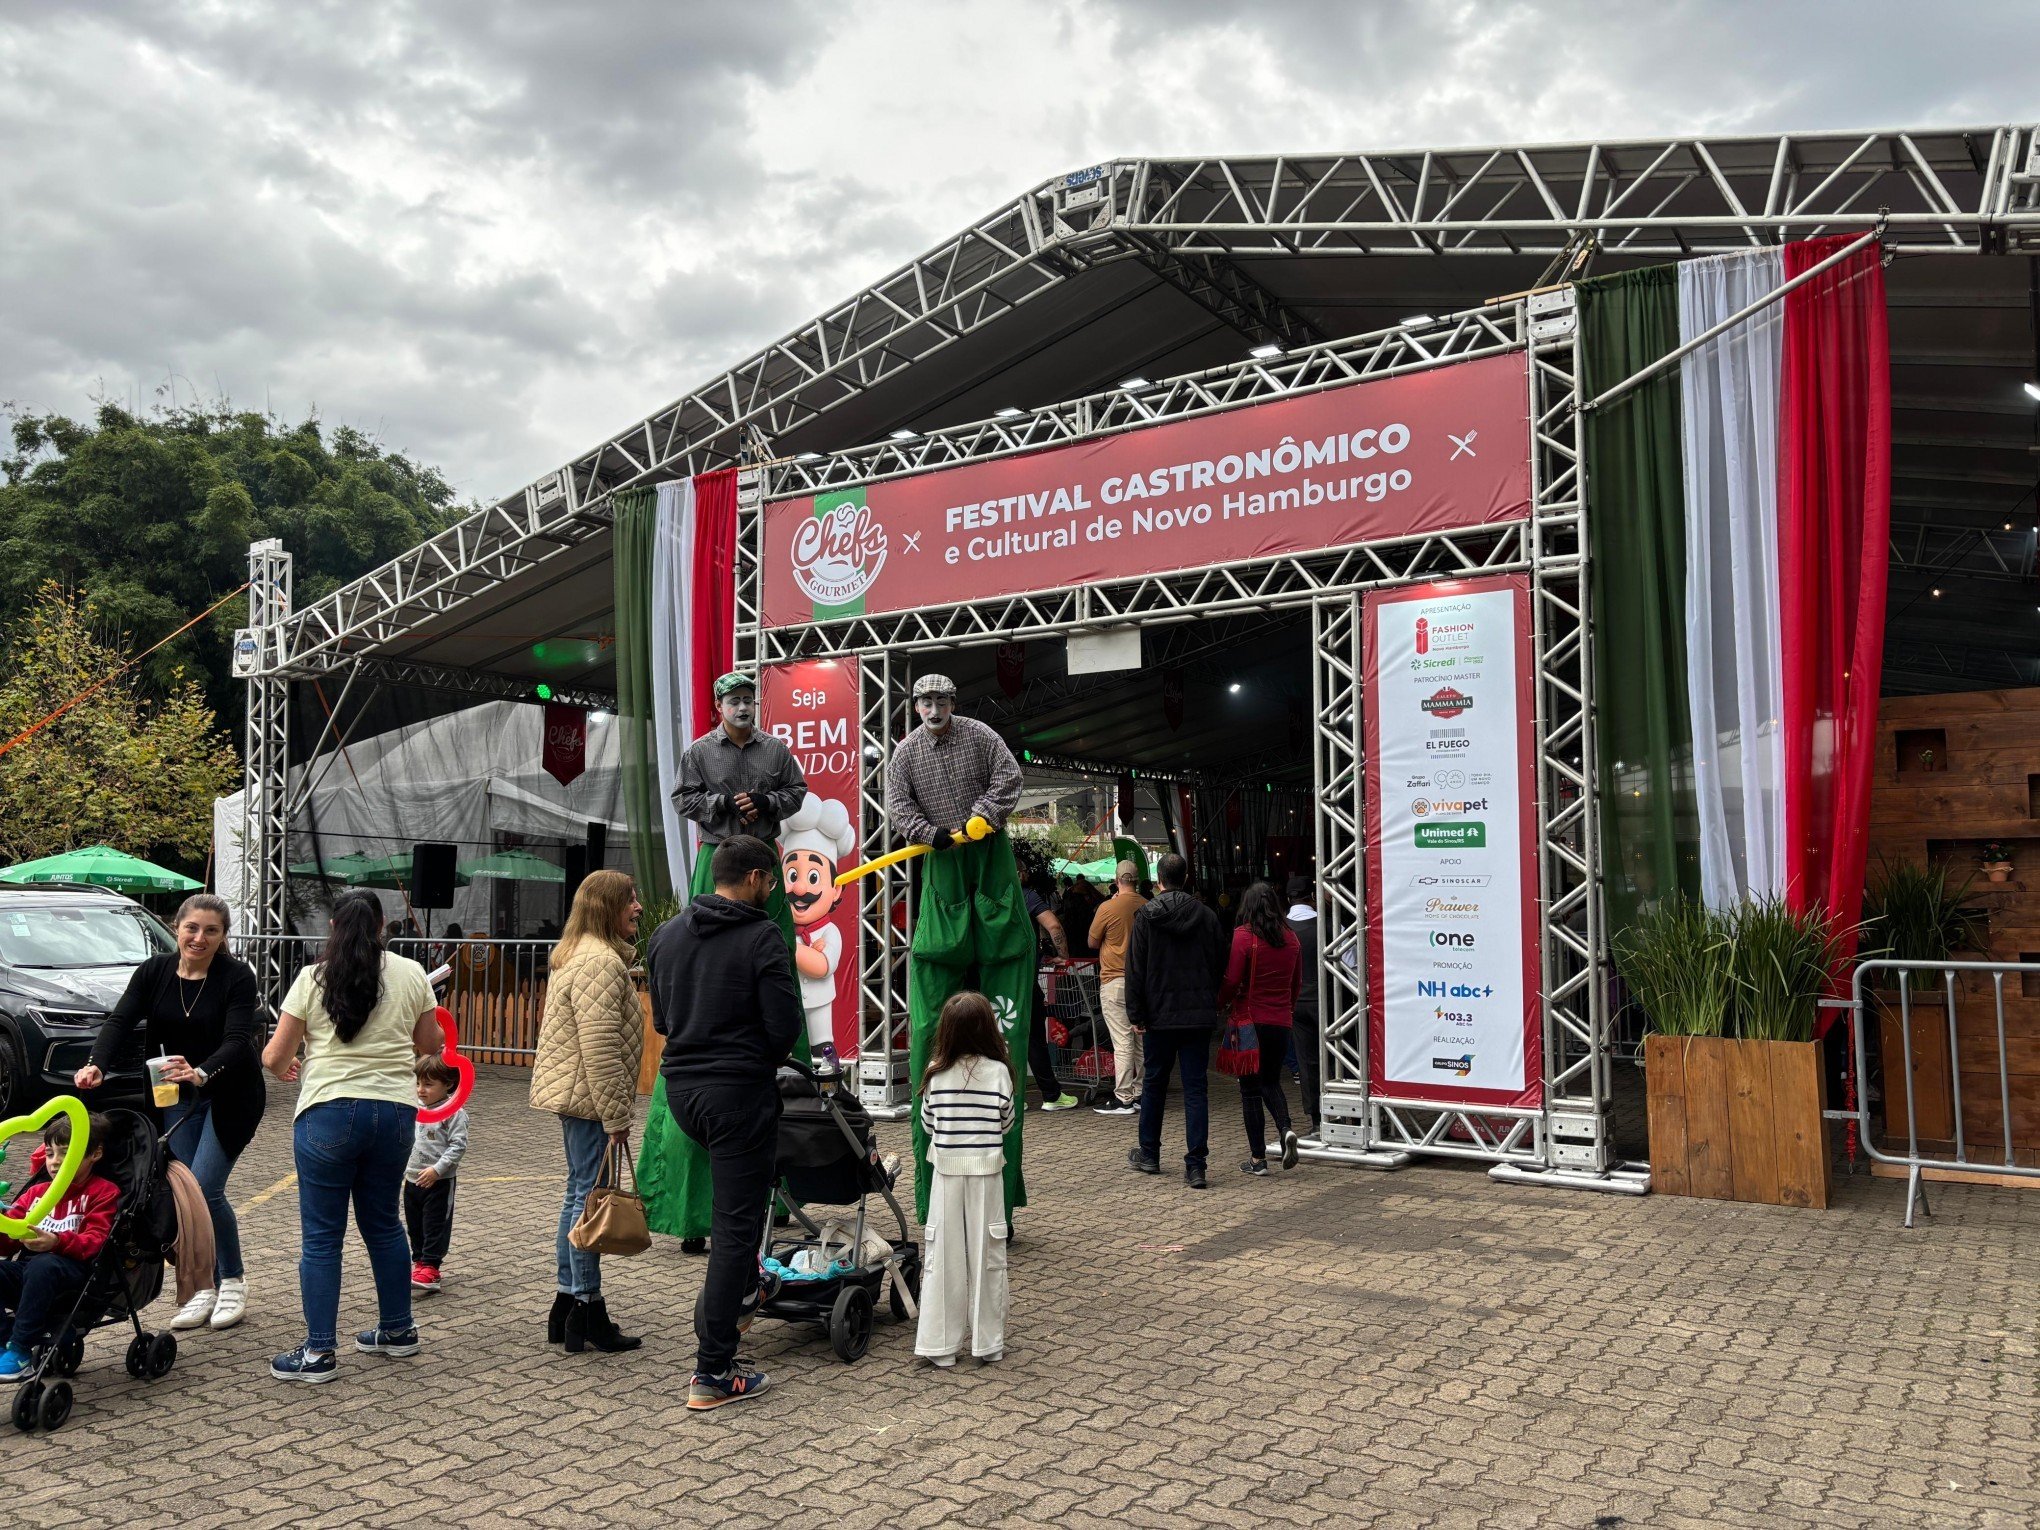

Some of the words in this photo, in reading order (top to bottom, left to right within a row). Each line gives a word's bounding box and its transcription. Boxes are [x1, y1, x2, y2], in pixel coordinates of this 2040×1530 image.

[946, 483, 1092, 534] FESTIVAL
[1100, 422, 1411, 506] GASTRONÔMICO
[943, 546, 960, 565] e
[967, 519, 1077, 561] Cultural
[1085, 513, 1123, 543] de
[1132, 503, 1213, 535] Novo
[1223, 468, 1413, 520] Hamburgo
[791, 505, 888, 570] Chefs
[808, 574, 868, 598] GOURMET
[1420, 604, 1471, 615] APRESENTAÇÃO
[1432, 623, 1475, 635] FASHION
[1432, 633, 1469, 643] OUTLET
[1423, 657, 1456, 668] Sicredi
[1413, 673, 1453, 684] PATROCÍNIO
[1454, 672, 1481, 682] MASTER
[792, 687, 826, 710] Seja
[1422, 700, 1454, 709] MAMMA
[1455, 698, 1472, 708] MIA
[772, 717, 848, 750] BEM
[1426, 741, 1437, 750] EL
[1438, 739, 1470, 749] FUEGO
[792, 750, 857, 776] NDO!
[1406, 780, 1431, 788] Zaffari
[1432, 797, 1489, 814] vivapet
[1421, 828, 1464, 837] Unimed
[1425, 898, 1479, 912] Prawer
[1432, 961, 1473, 970] PROMOÇÃO
[1417, 980, 1446, 998] NH
[1444, 1012, 1473, 1022] 103.3
[1433, 1035, 1475, 1045] REALIZAÇÃO
[1447, 1060, 1469, 1069] SINOS
[731, 1376, 746, 1393] N
